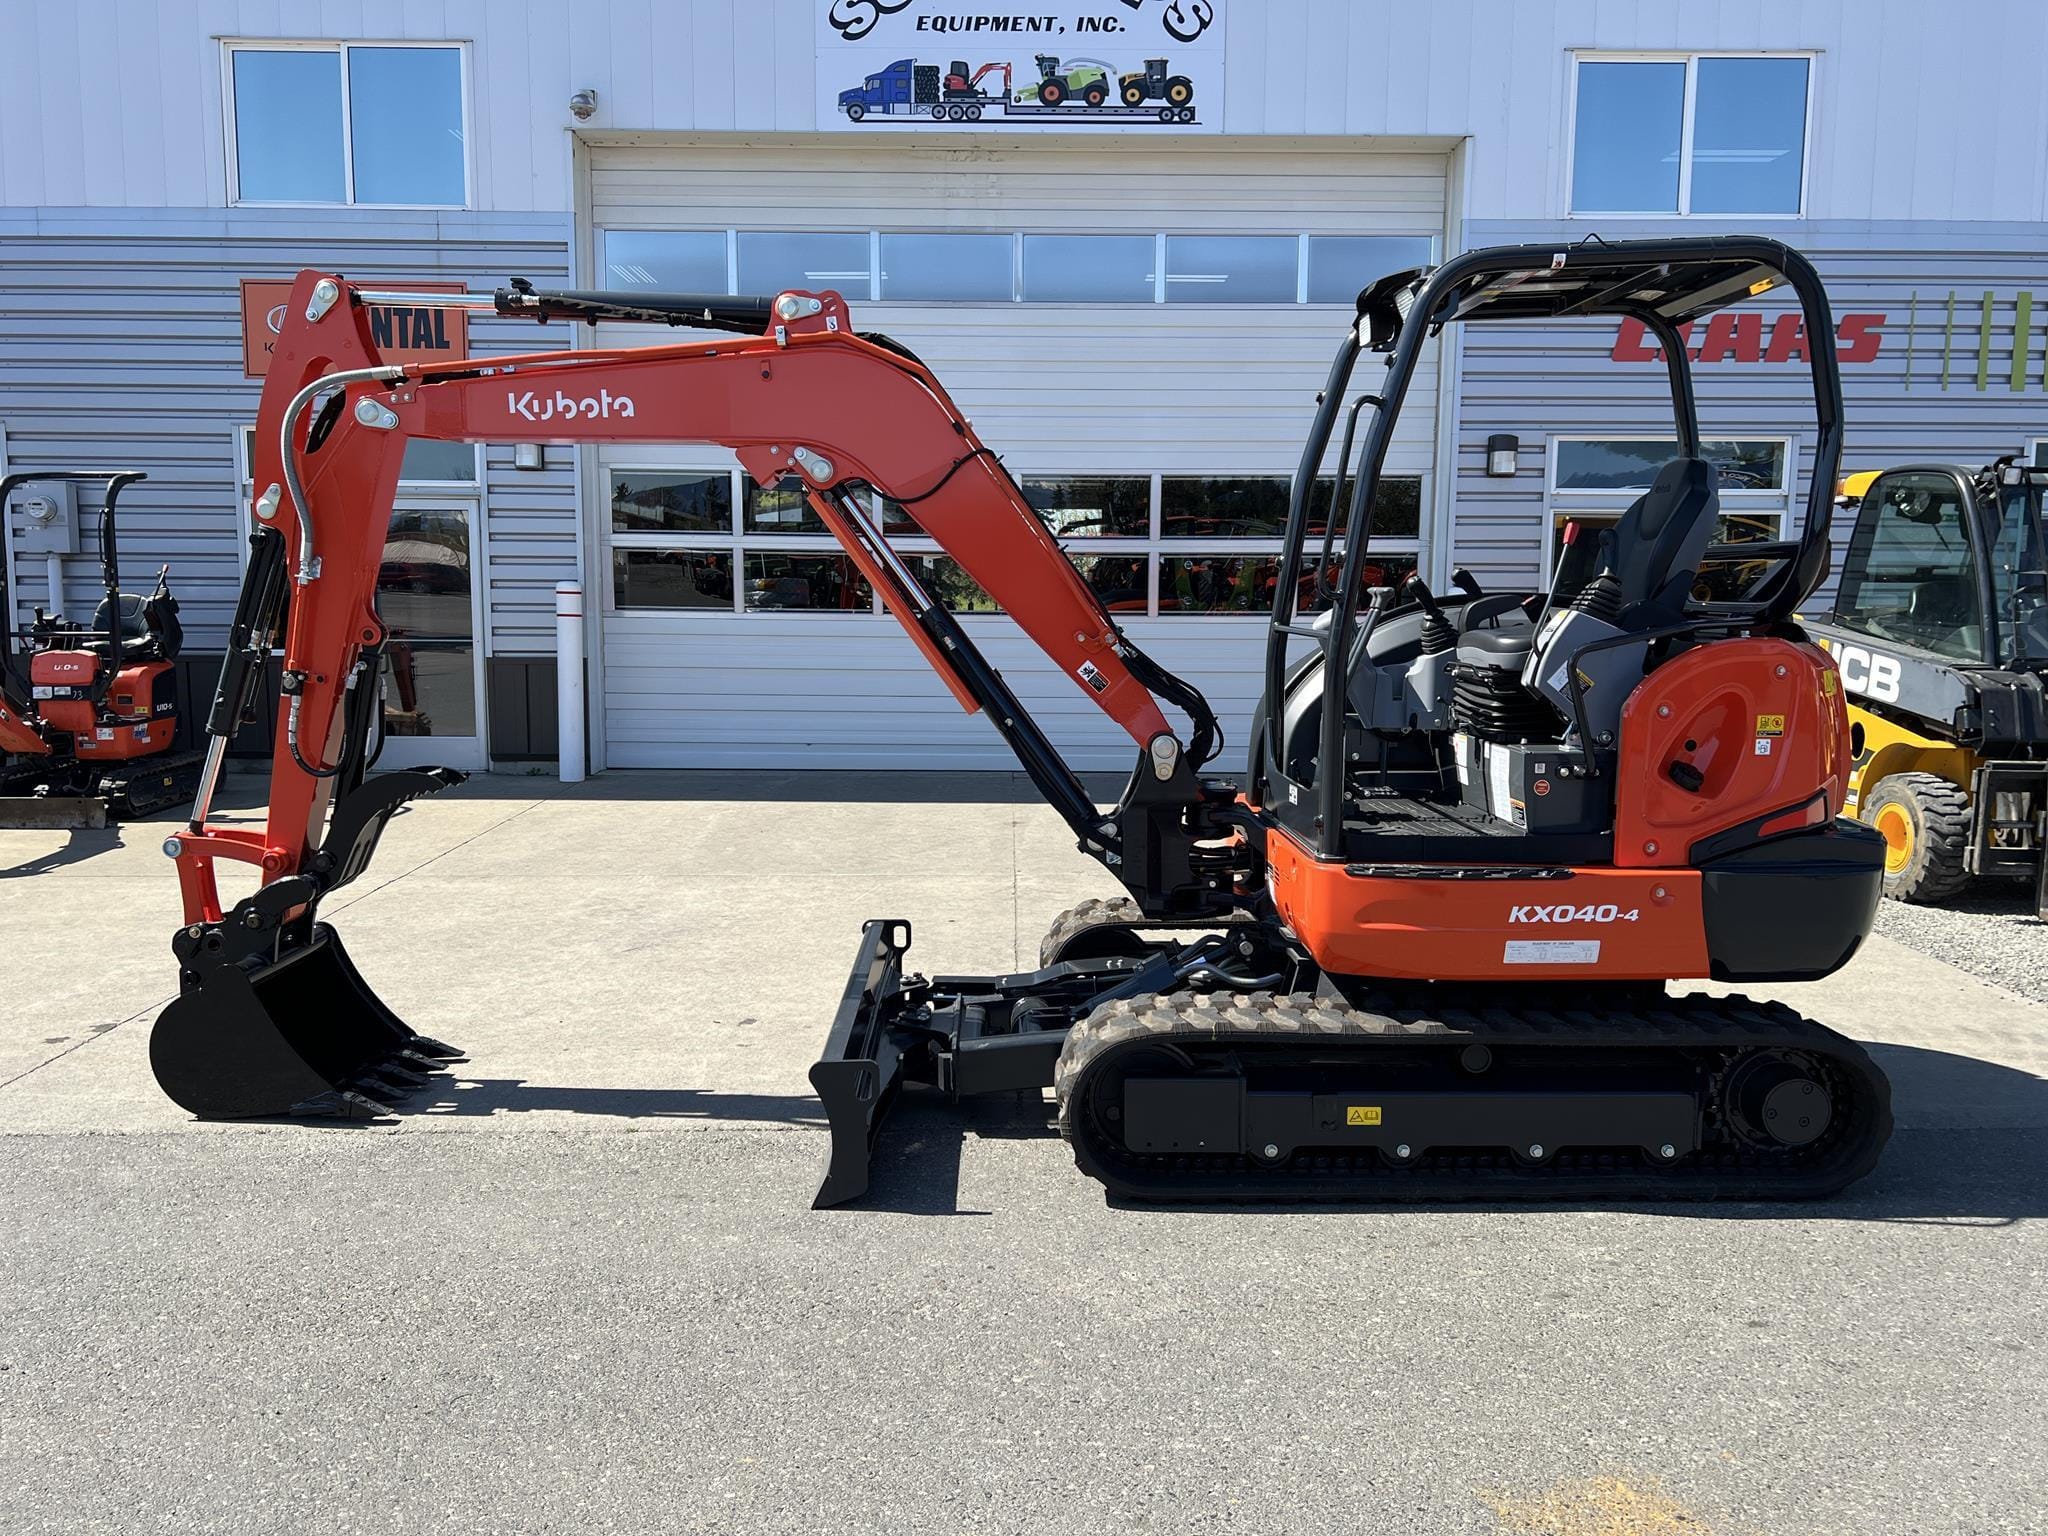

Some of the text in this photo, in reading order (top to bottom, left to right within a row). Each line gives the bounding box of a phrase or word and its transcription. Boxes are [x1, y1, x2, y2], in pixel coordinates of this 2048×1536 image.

[916, 15, 1065, 34] EQUIPMENT,
[1076, 16, 1126, 33] INC.
[367, 307, 450, 349] NTAL
[508, 389, 635, 421] Kubota
[1832, 642, 1901, 703] CB
[1508, 904, 1639, 923] KX040-4
